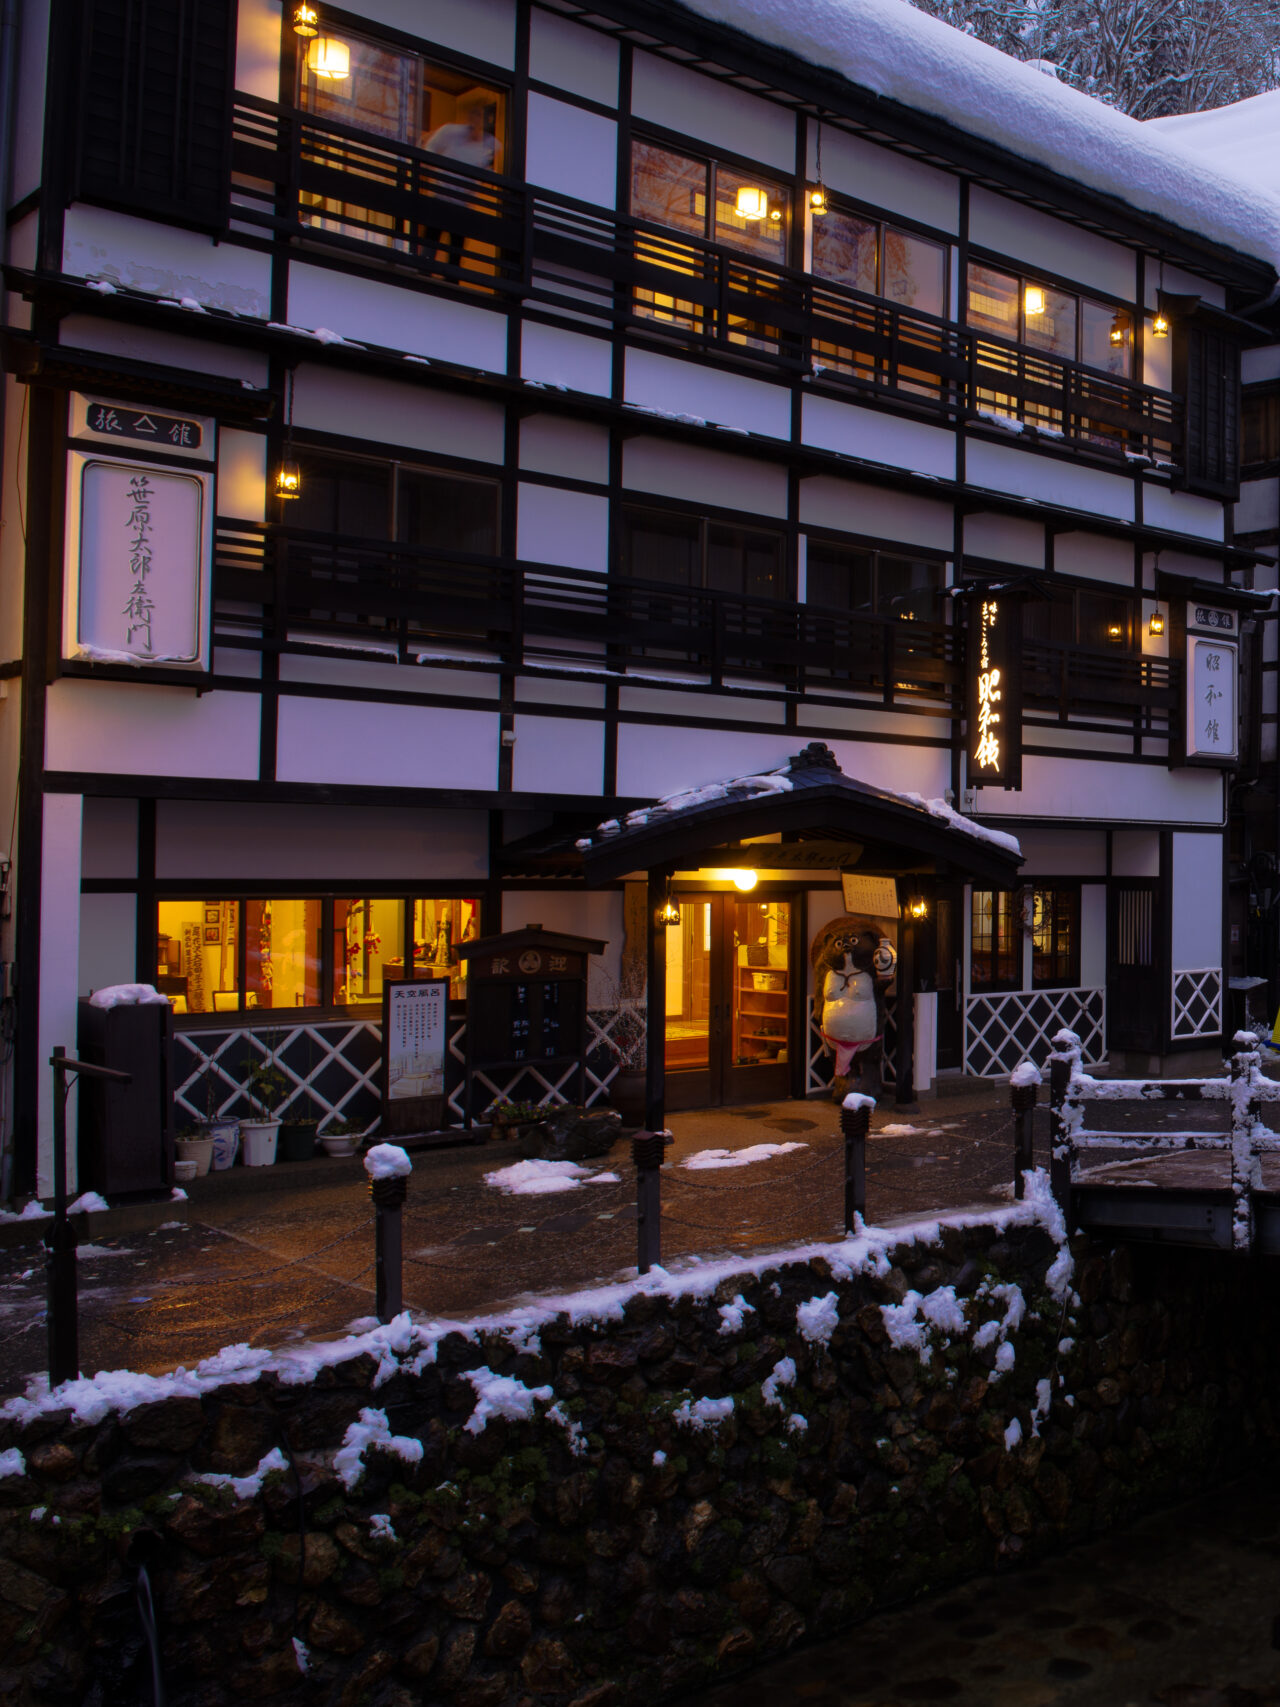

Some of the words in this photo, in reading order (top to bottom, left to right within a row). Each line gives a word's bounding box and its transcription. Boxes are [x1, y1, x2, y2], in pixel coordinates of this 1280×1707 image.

[1204, 653, 1223, 744] 昭和館
[394, 988, 441, 999] 天空風呂
